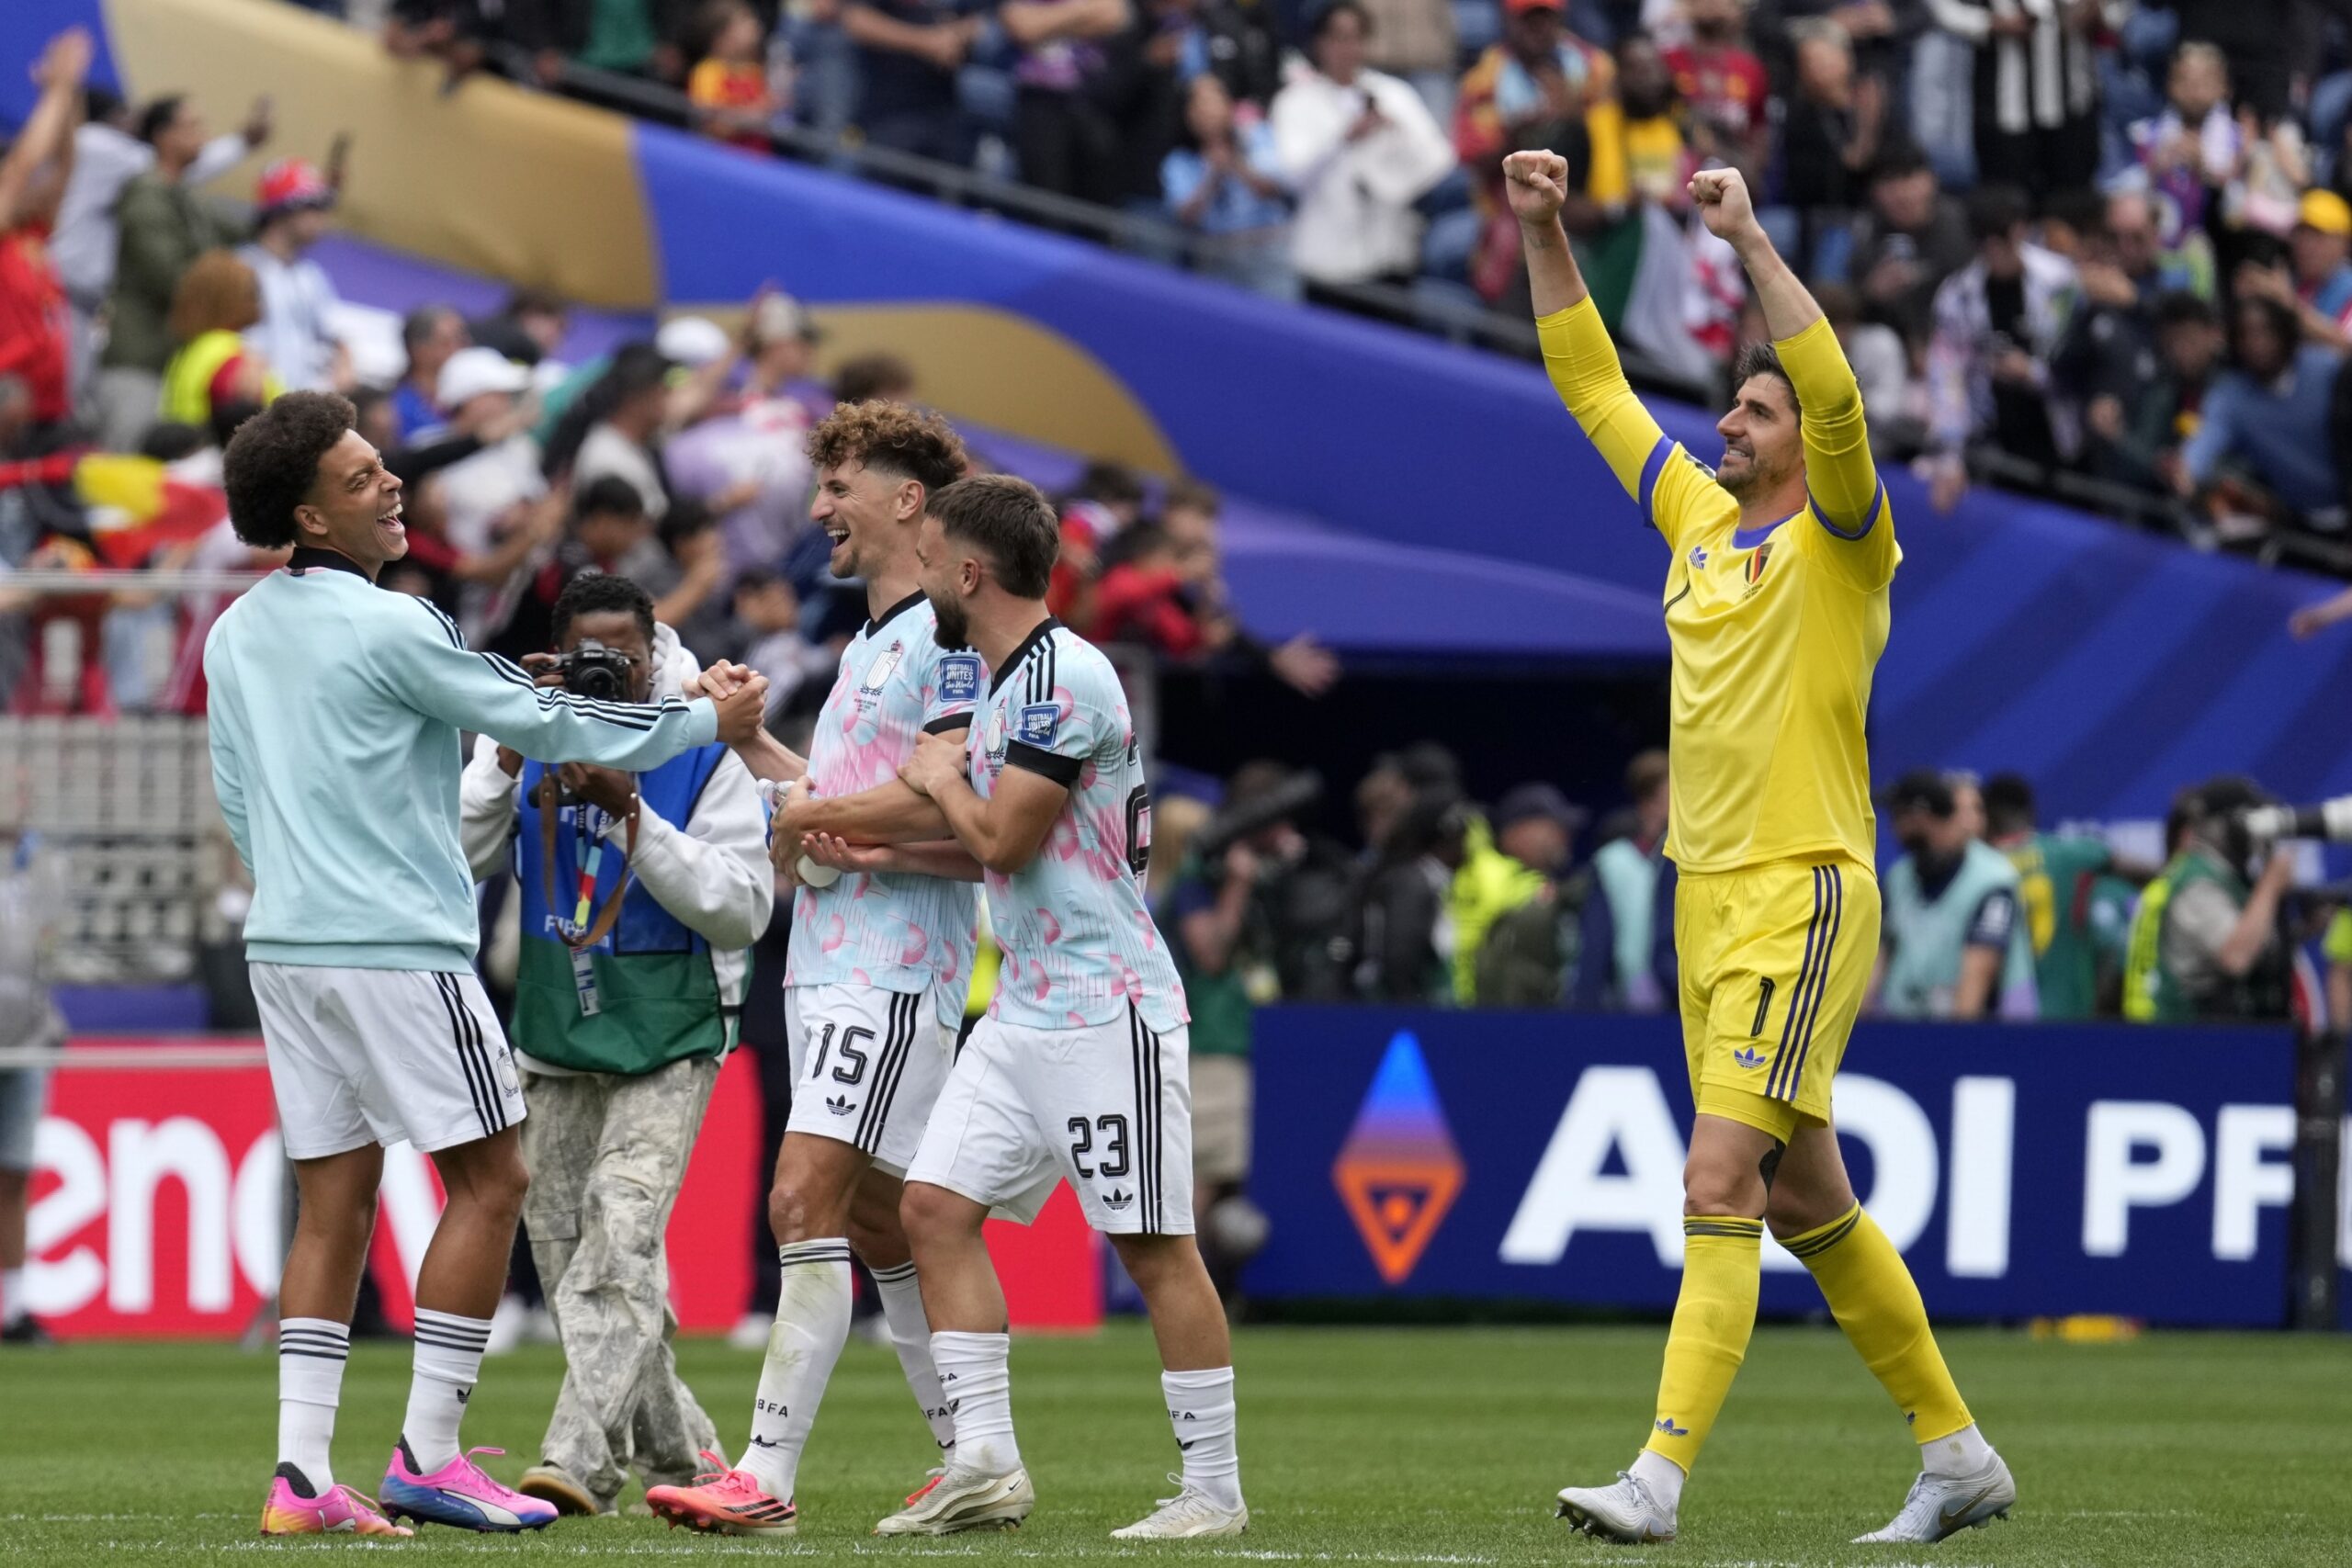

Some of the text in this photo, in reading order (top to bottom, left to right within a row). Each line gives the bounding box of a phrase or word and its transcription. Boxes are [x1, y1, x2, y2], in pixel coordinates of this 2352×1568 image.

[946, 671, 974, 681] UNITES
[1750, 976, 1776, 1039] 1
[812, 1022, 876, 1088] 15
[1068, 1113, 1131, 1180] 23
[757, 1398, 788, 1418] BFA
[921, 1406, 948, 1420] FA
[1167, 1408, 1195, 1420] FA
